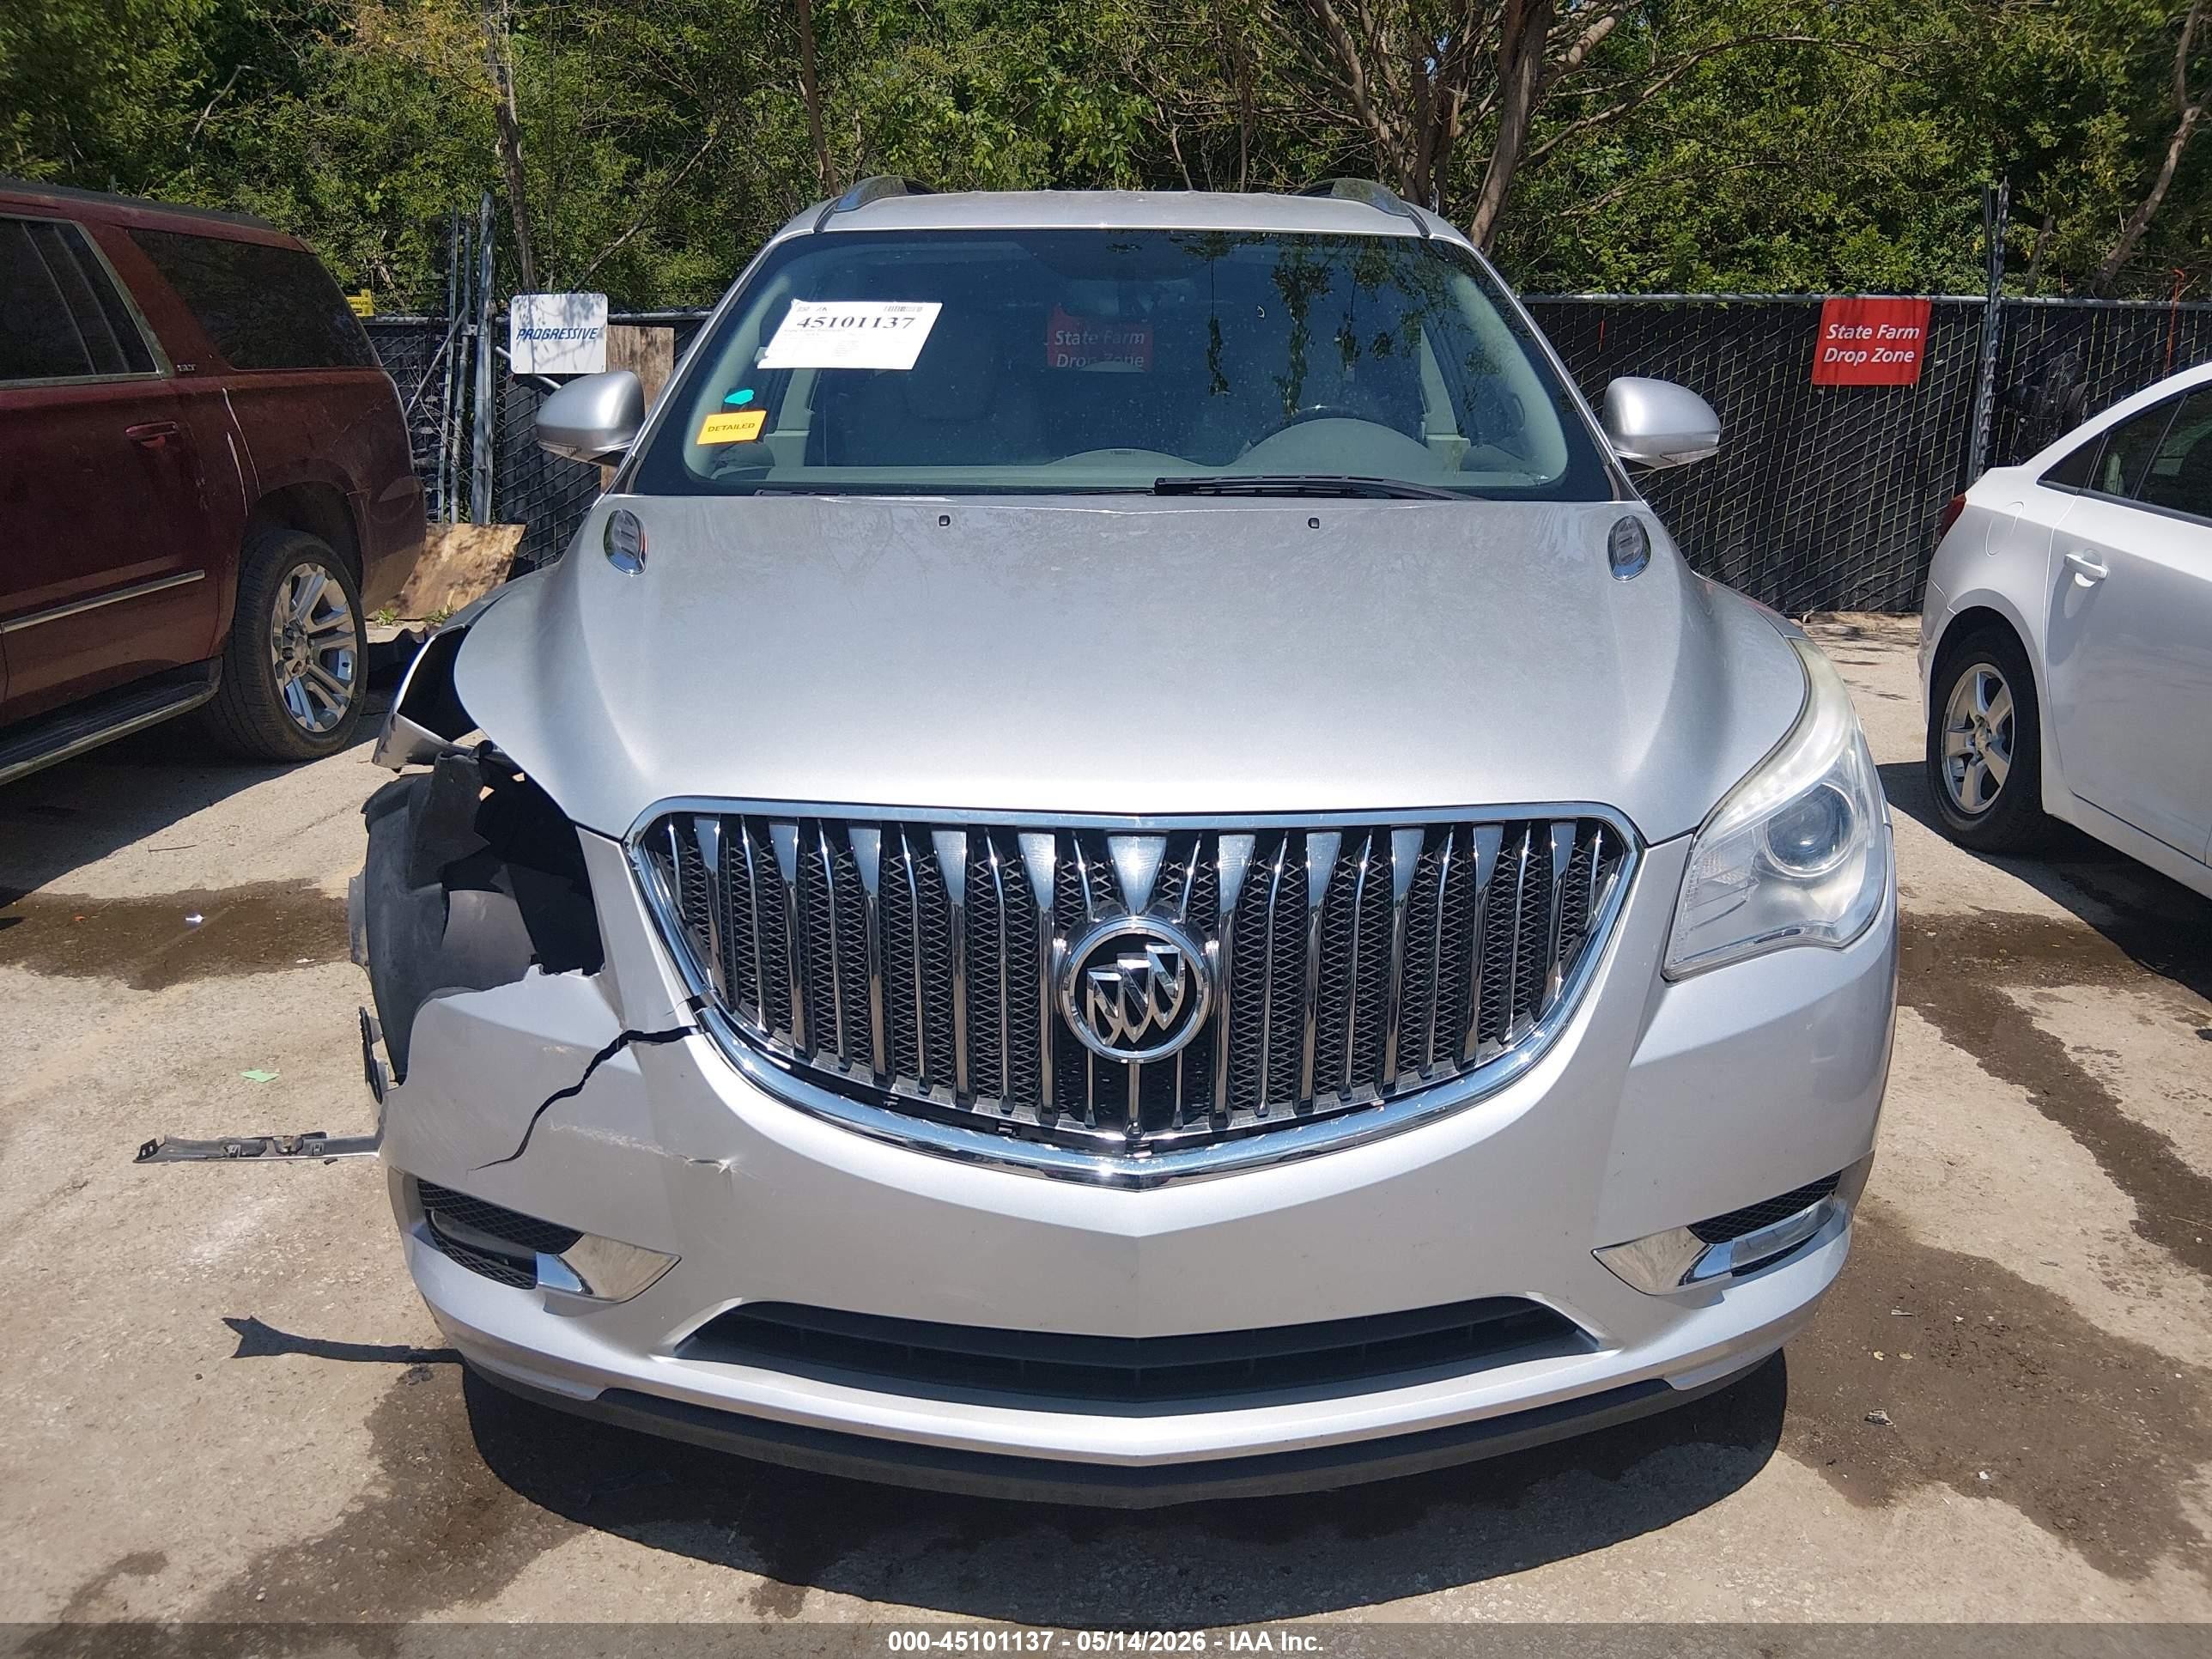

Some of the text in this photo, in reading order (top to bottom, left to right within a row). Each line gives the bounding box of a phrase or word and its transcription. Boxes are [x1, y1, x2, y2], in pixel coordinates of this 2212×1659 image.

[796, 316, 916, 329] 45101137
[516, 328, 599, 340] PROGRESSIVE
[1054, 330, 1145, 345] State Farm
[1826, 324, 1920, 339] State Farm
[1823, 347, 1915, 366] Drop Zone
[708, 423, 756, 432] DETAILED
